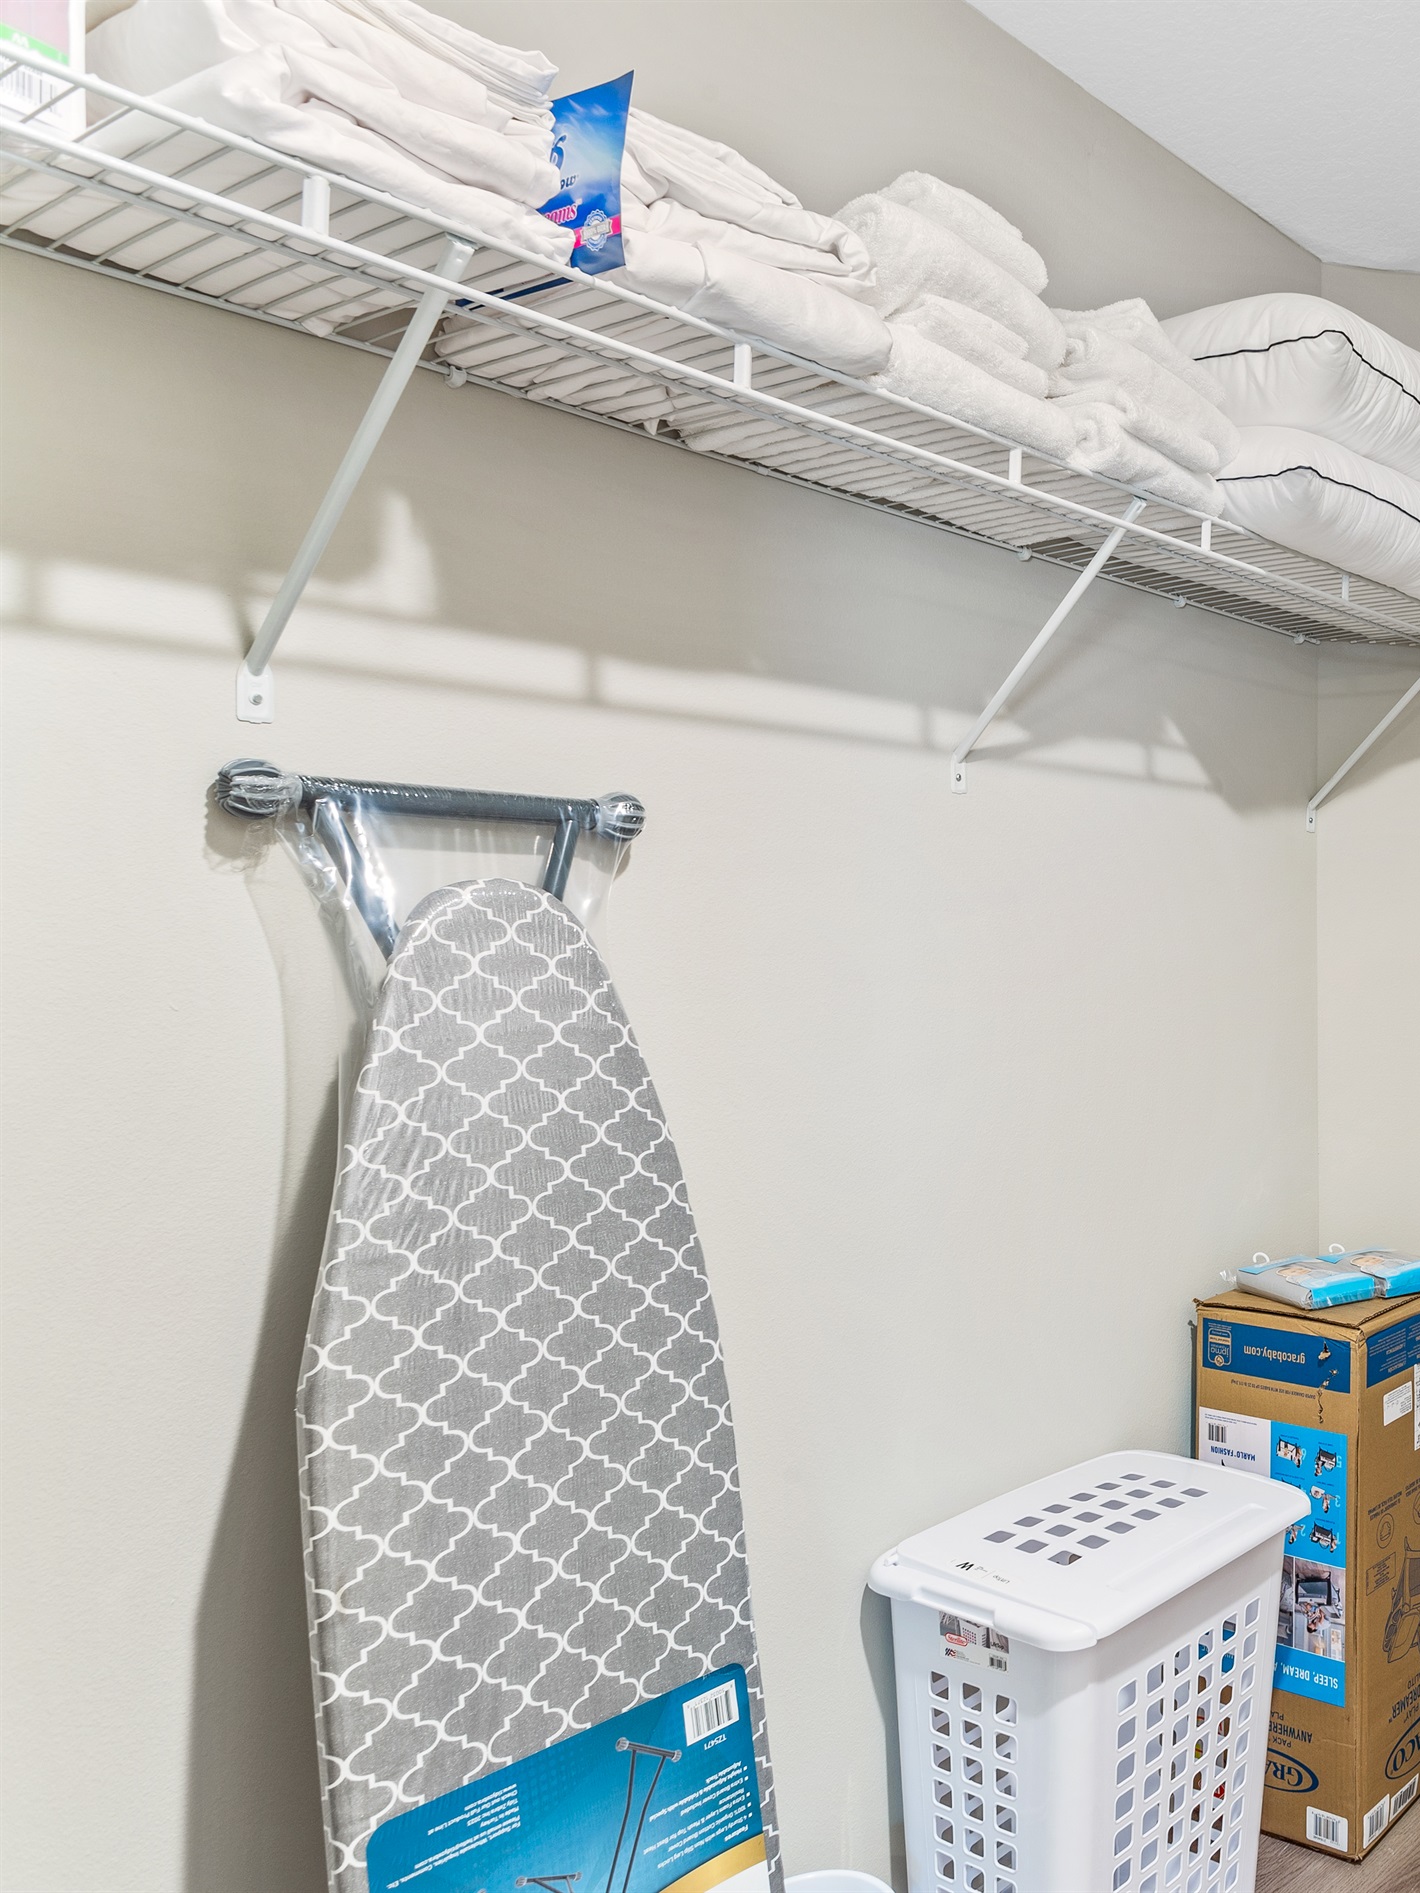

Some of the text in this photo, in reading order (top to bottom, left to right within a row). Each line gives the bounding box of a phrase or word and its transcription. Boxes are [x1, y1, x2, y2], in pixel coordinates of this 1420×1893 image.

[1211, 1347, 1229, 1358] jpma
[1244, 1344, 1305, 1364] gracobaby.com
[1211, 1446, 1255, 1461] MARLO FASHION
[1336, 1455, 1342, 1468] 5
[1335, 1495, 1340, 1508] 3
[1300, 1524, 1306, 1536] 2
[1281, 1662, 1338, 1689] SLEEP. DREAM.
[1270, 1711, 1284, 1721] PLA
[1272, 1736, 1291, 1748] PACK
[501, 1790, 517, 1801] Check
[681, 1778, 743, 1816] Extra Board Cover Included
[732, 1795, 745, 1806] Extra
[480, 1802, 490, 1811] Our
[491, 1798, 501, 1806] out
[506, 1797, 518, 1808] Tidy
[719, 1802, 732, 1814] Foam
[470, 1807, 480, 1816] Full
[491, 1803, 507, 1815] Zebra
[505, 1806, 519, 1816] Made
[705, 1808, 718, 1821] Layer
[448, 1812, 470, 1826] Product
[480, 1814, 499, 1828] Turkey
[502, 1815, 520, 1828] Please
[715, 1811, 733, 1826] Organic
[728, 1816, 743, 1830] Sturdy
[434, 1822, 447, 1833] Line
[486, 1824, 502, 1835] email
[511, 1821, 520, 1830] For
[699, 1822, 715, 1835] Cotton
[716, 1825, 727, 1837] Legs
[683, 1831, 698, 1844] Board
[705, 1833, 715, 1843] with
[724, 1824, 748, 1842] Features
[668, 1840, 683, 1852] Cover
[674, 1850, 684, 1860] Leg
[658, 1856, 674, 1869] Locks
